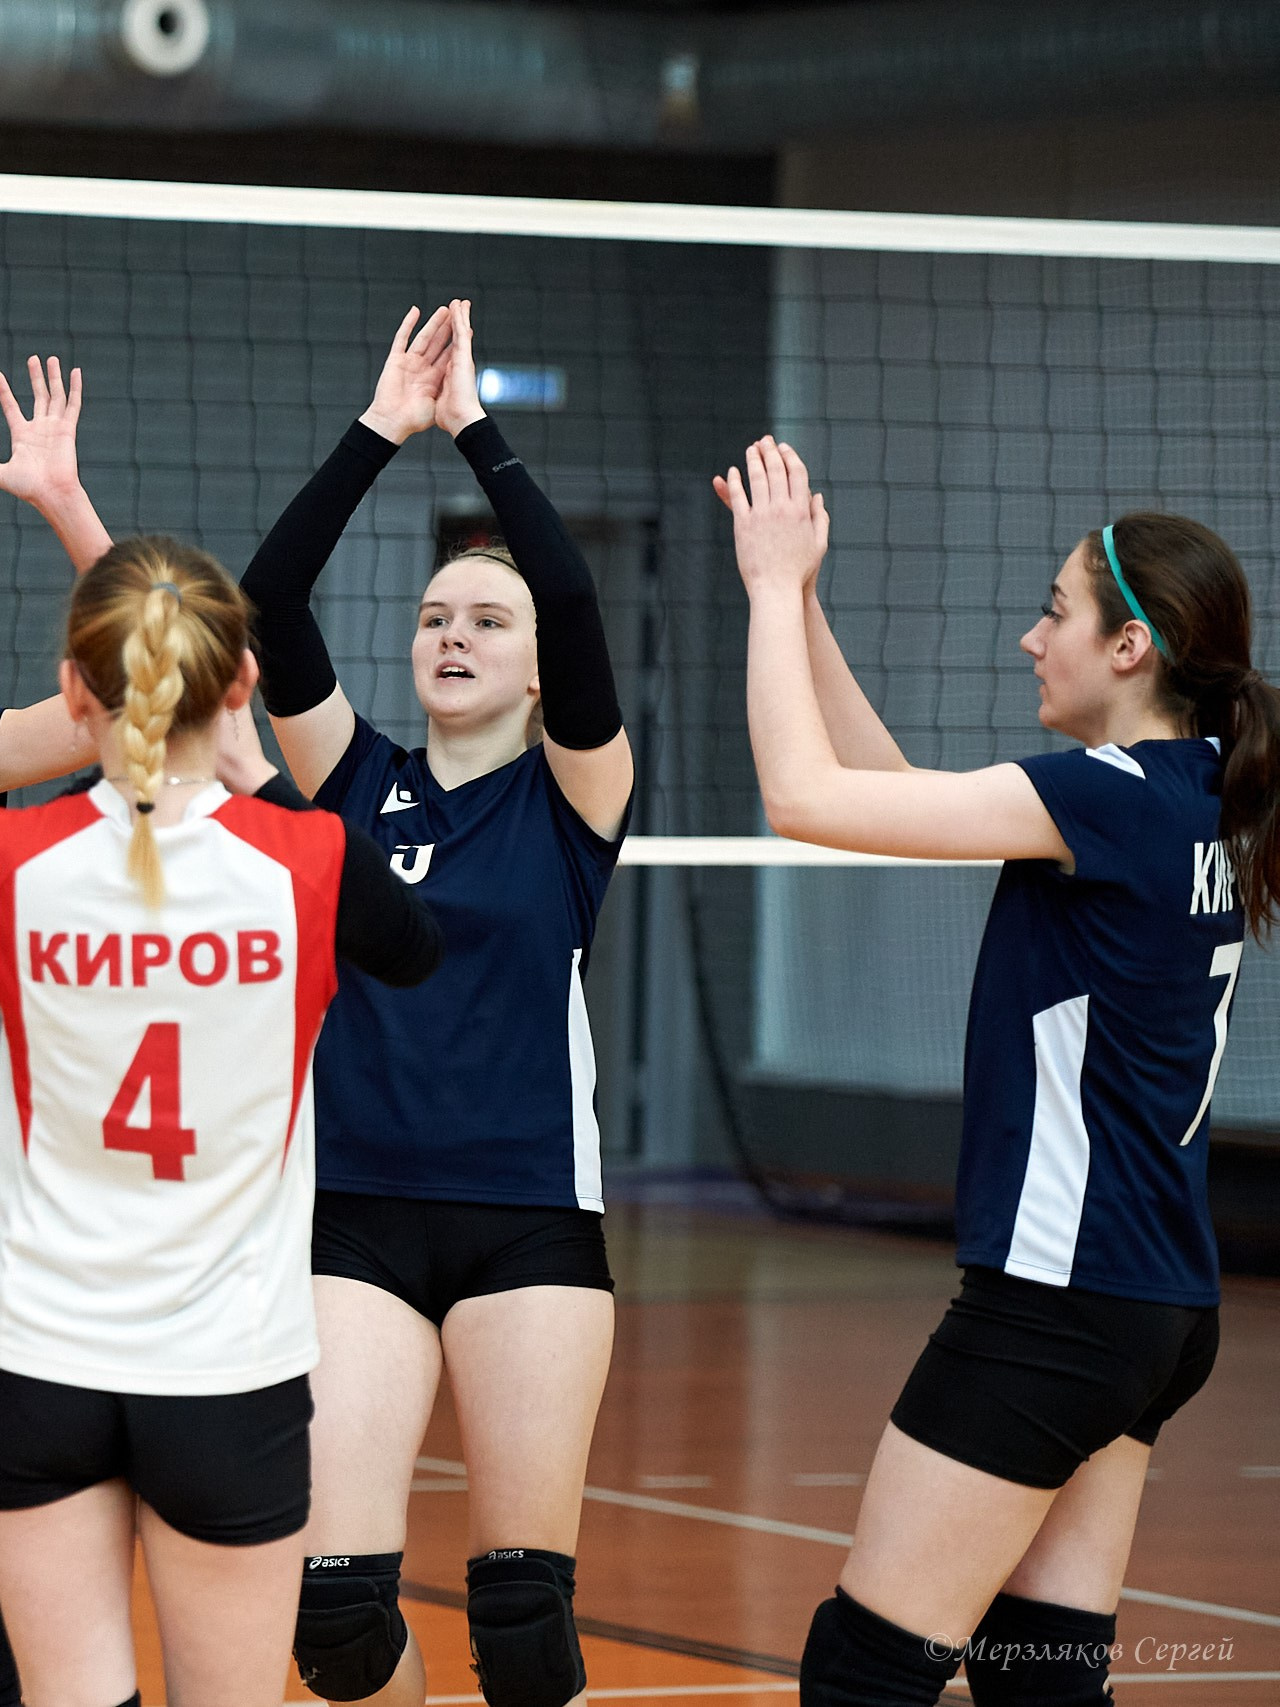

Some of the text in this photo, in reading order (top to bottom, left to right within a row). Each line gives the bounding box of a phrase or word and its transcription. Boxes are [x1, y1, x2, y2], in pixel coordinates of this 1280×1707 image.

[29, 930, 284, 988] КИРОВ
[102, 1022, 197, 1182] 4
[1179, 941, 1243, 1146] 7
